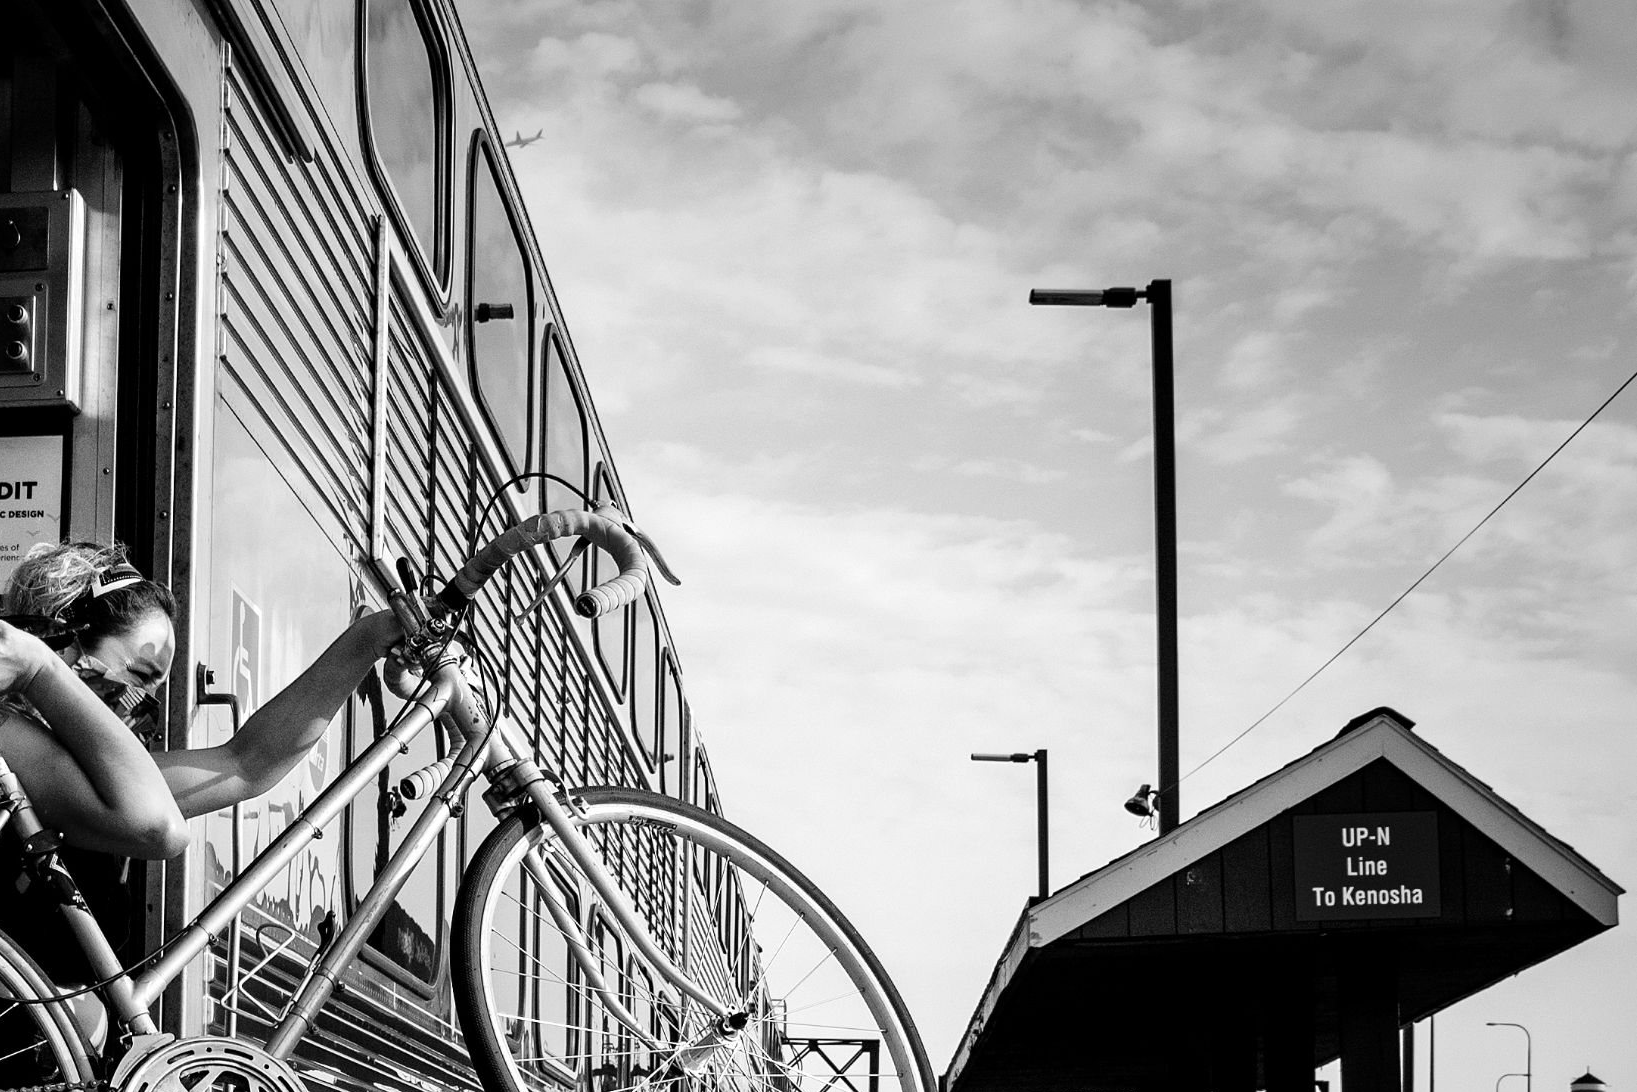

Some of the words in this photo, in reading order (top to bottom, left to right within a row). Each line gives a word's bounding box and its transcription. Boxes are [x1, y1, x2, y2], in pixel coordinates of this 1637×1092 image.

[8, 510, 45, 518] DESIGN
[1342, 826, 1390, 847] UP-N
[1346, 856, 1388, 876] Line
[1312, 886, 1336, 906] To
[1342, 884, 1423, 905] Kenosha
